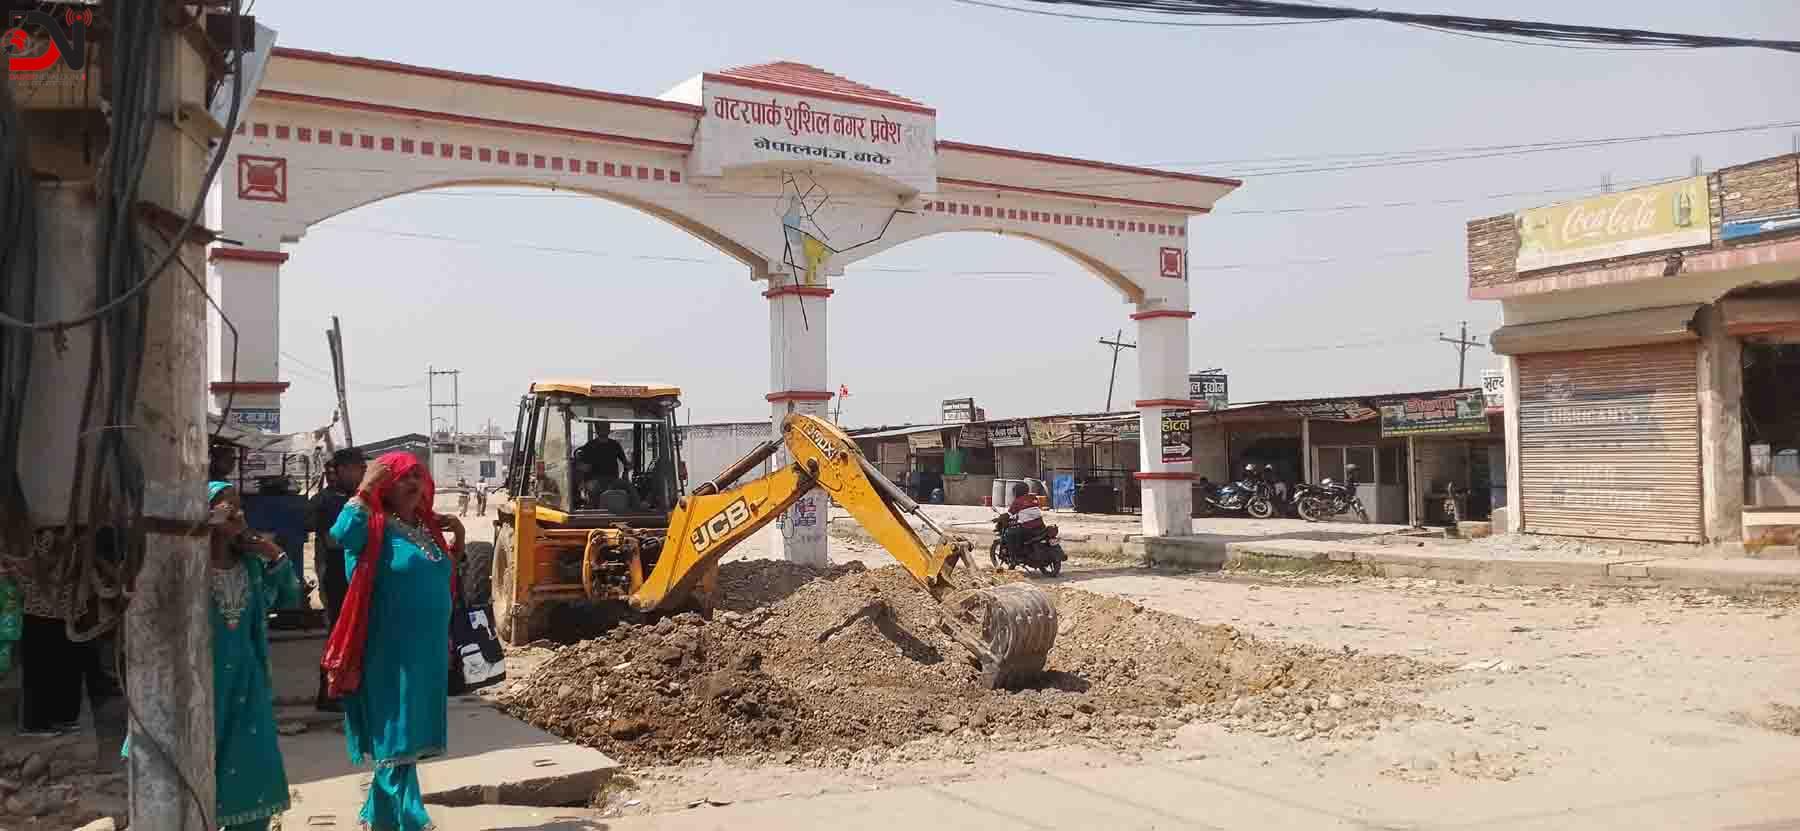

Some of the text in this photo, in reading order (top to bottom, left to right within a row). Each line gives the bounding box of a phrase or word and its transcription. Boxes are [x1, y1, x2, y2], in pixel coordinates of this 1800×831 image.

[713, 96, 782, 126] वाटरपार्क
[784, 101, 831, 136] शुशिल
[832, 114, 866, 139] नगर
[870, 114, 902, 145] प्रवेश
[1162, 416, 1189, 432] होटल
[691, 500, 750, 551] JCB
